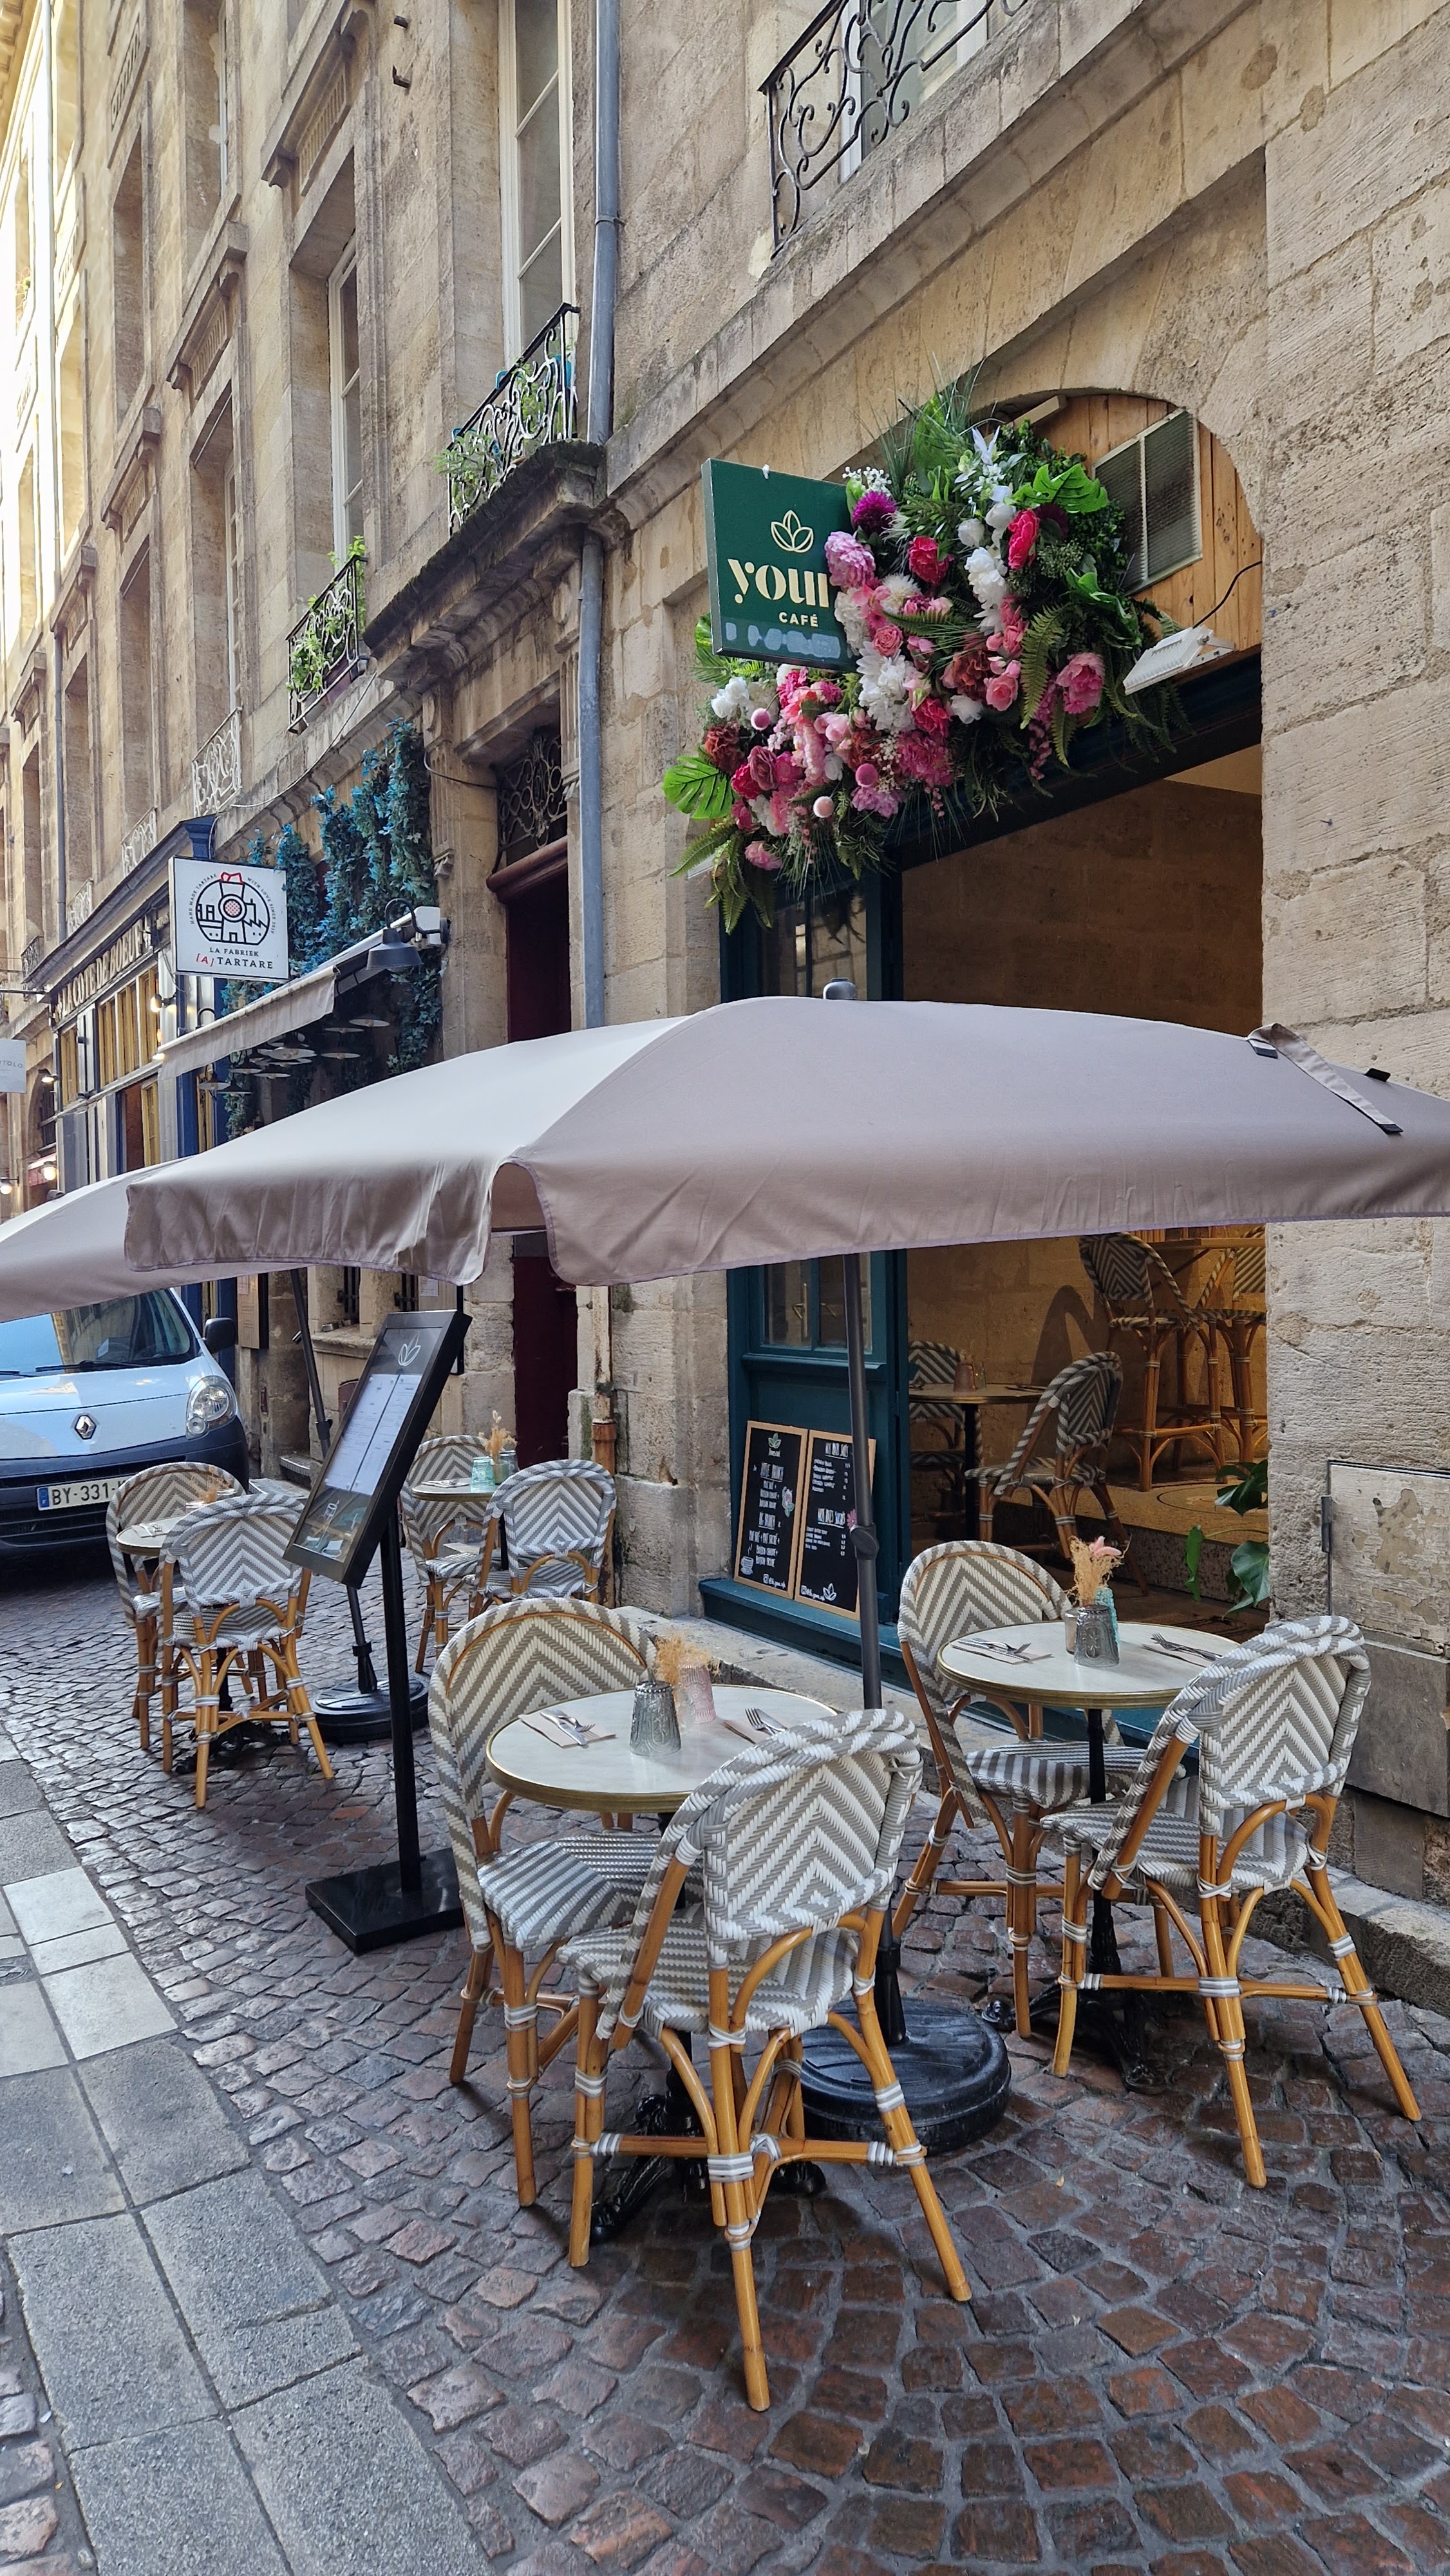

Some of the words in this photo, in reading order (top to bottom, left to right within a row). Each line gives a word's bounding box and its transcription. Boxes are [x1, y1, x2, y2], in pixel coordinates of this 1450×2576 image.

[778, 612, 818, 627] CAFÉ
[189, 890, 198, 905] MADE
[196, 873, 217, 889] TARTARE
[247, 877, 261, 889] WITH
[261, 888, 271, 902] LOVE
[217, 956, 273, 969] TARTARE
[223, 948, 259, 957] FABRIEK
[62, 982, 75, 1018] LA
[95, 950, 110, 990] DE
